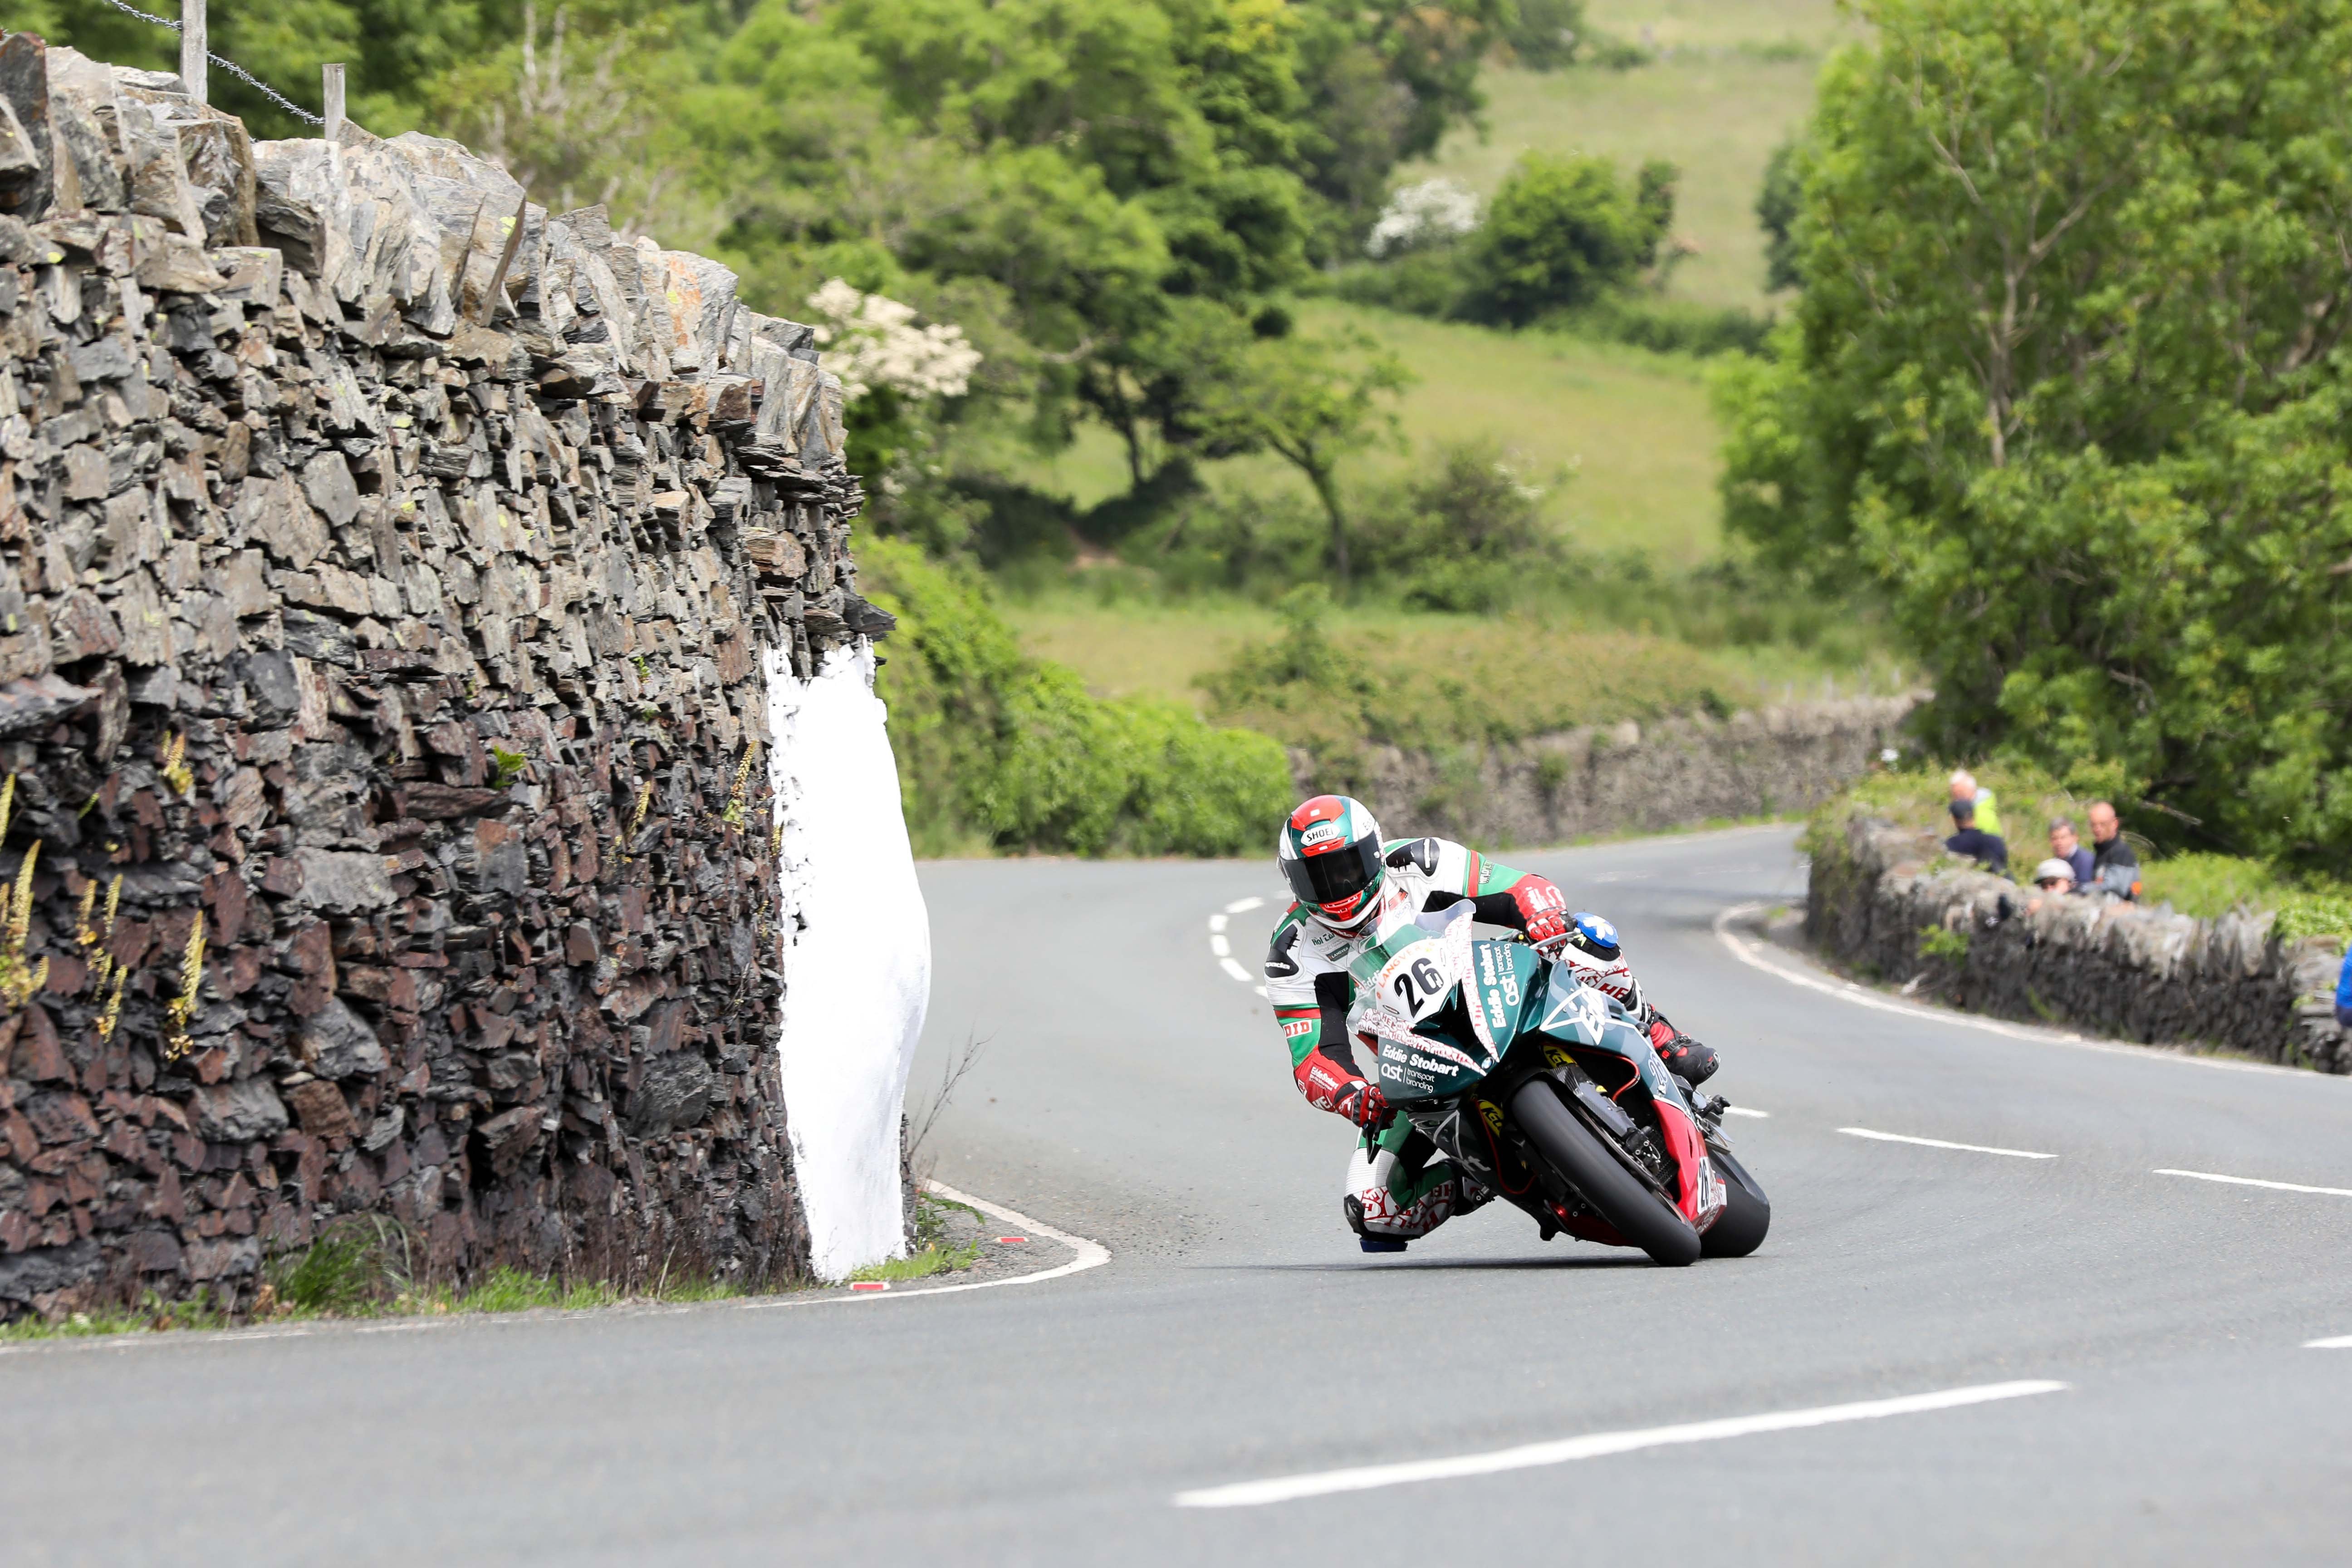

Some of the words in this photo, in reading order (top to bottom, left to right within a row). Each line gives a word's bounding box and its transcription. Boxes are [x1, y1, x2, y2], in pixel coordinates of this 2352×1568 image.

[1307, 828, 1333, 842] SHOEI
[1479, 943, 1497, 986] Stobart
[1494, 946, 1504, 972] transport
[1503, 943, 1514, 970] branding
[1394, 957, 1444, 1019] 26
[1488, 989, 1506, 1028] Eddie
[1381, 1063, 1403, 1082] ast
[1382, 1044, 1407, 1063] Eddie
[1409, 1054, 1459, 1077] Stobart
[1406, 1077, 1433, 1093] branding
[1407, 1068, 1435, 1082] transport
